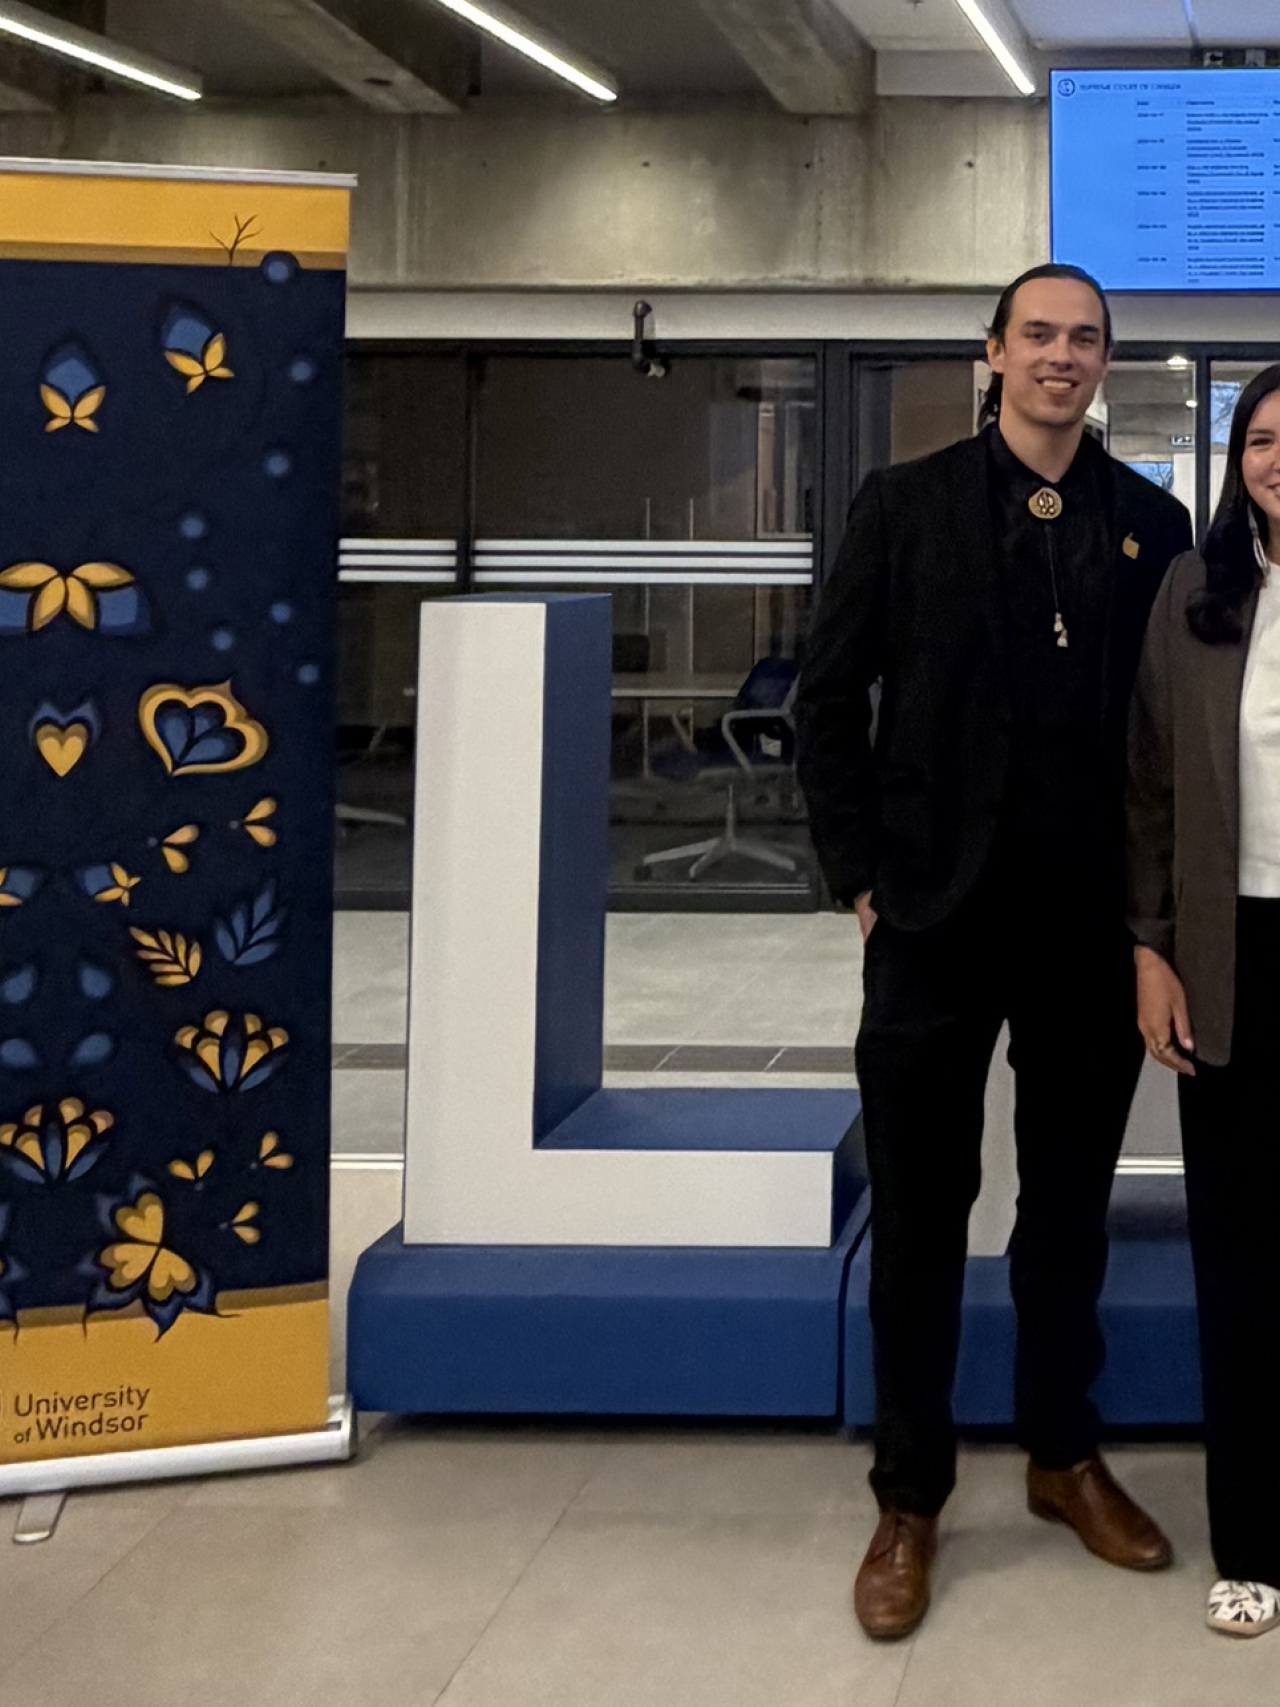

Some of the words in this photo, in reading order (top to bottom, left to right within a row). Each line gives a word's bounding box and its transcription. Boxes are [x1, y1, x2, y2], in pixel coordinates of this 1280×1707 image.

[14, 1384, 151, 1417] University
[13, 1427, 31, 1444] of
[36, 1411, 149, 1441] Windsor
